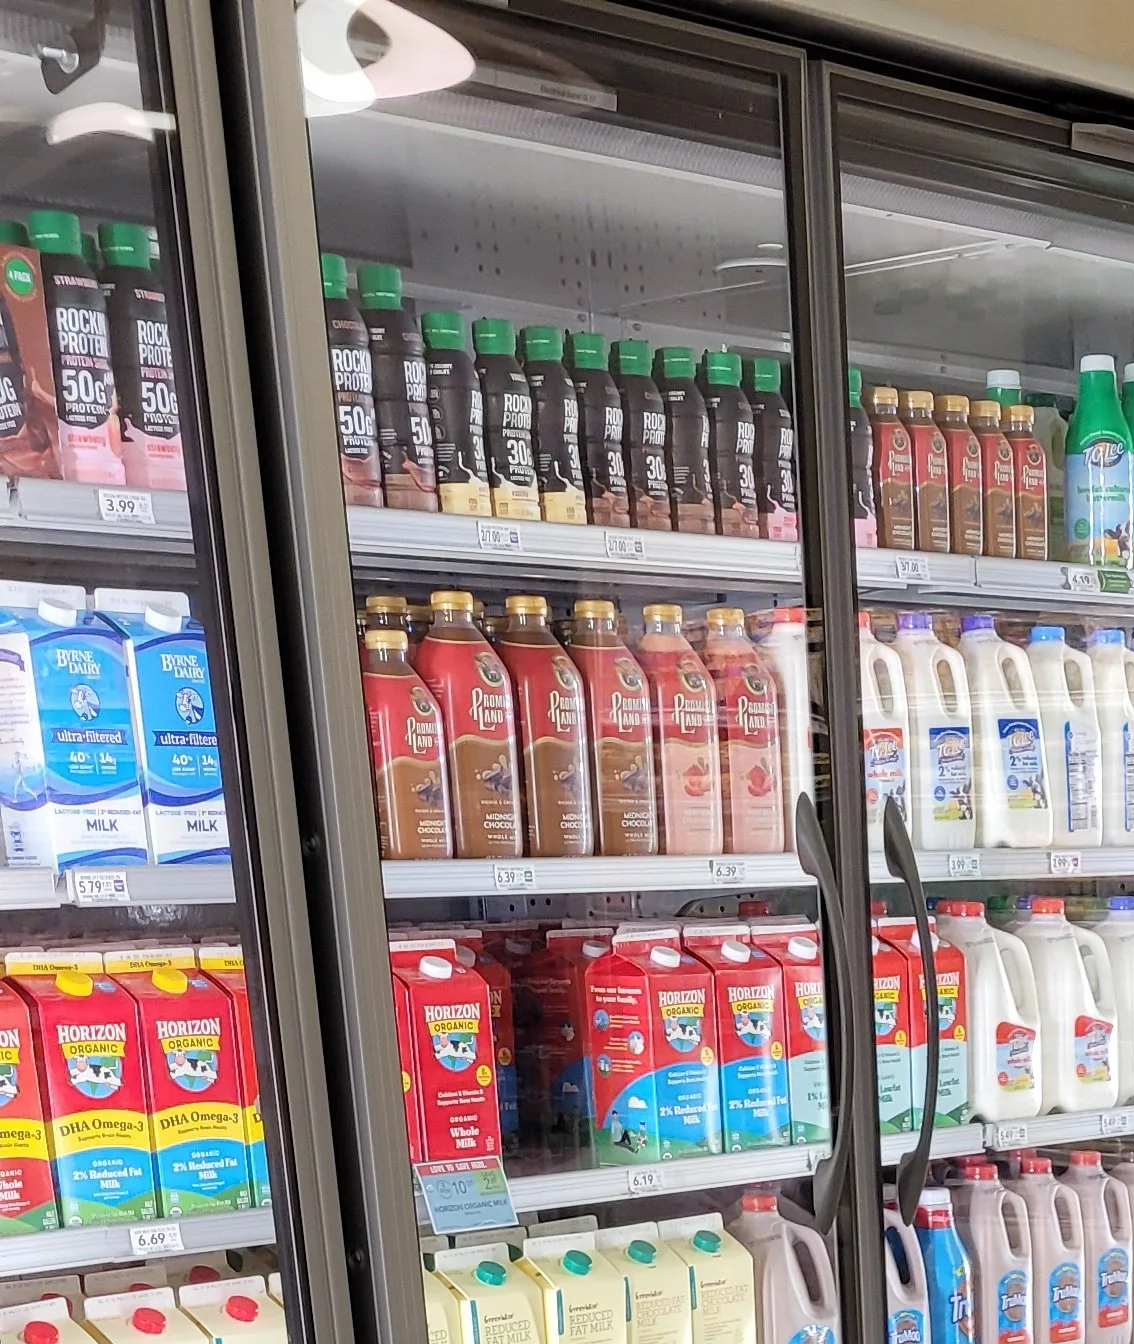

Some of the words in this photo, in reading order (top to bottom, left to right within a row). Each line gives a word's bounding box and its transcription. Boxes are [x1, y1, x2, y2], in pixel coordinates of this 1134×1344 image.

[105, 498, 136, 514] 3.99
[56, 648, 95, 669] BYRNE
[160, 653, 199, 673] BYRNE
[69, 661, 101, 677] DAIRY
[174, 666, 206, 681] DAIRY
[86, 819, 119, 832] MILK
[187, 820, 218, 833] MILK
[716, 866, 736, 877] 6.39
[658, 988, 706, 1005] HORIZON
[727, 984, 775, 1000] HORIZON
[424, 1003, 480, 1022] HORIZON
[666, 1007, 699, 1016] ORGANIC
[736, 1002, 770, 1012] ORGANIC
[56, 1022, 126, 1044] HORIZON
[156, 1017, 220, 1039] HORIZON
[434, 1021, 474, 1032] ORGANIC
[69, 1044, 118, 1055] ORGANIC
[168, 1038, 213, 1049] ORGANIC
[160, 1114, 189, 1130] DHA
[191, 1111, 239, 1123] Omega-3
[59, 1120, 90, 1137] DHA
[92, 1118, 143, 1132] Omega-3
[450, 1126, 480, 1138] Whole
[456, 1138, 477, 1149] Milk
[173, 1161, 188, 1172] 2%
[188, 1159, 223, 1171] Reduced
[73, 1171, 89, 1180] 2%
[89, 1169, 126, 1179] Reduced
[128, 1168, 142, 1178] Fat
[198, 1169, 218, 1180] Milk
[633, 1173, 654, 1186] 6.19
[100, 1178, 120, 1190] Milk
[138, 1233, 166, 1246] 6.69
[569, 1310, 614, 1326] REDUCED
[485, 1320, 531, 1337] REDUCED
[570, 1325, 589, 1337] FAT
[590, 1321, 614, 1332] MILK
[507, 1331, 532, 1344] MILK
